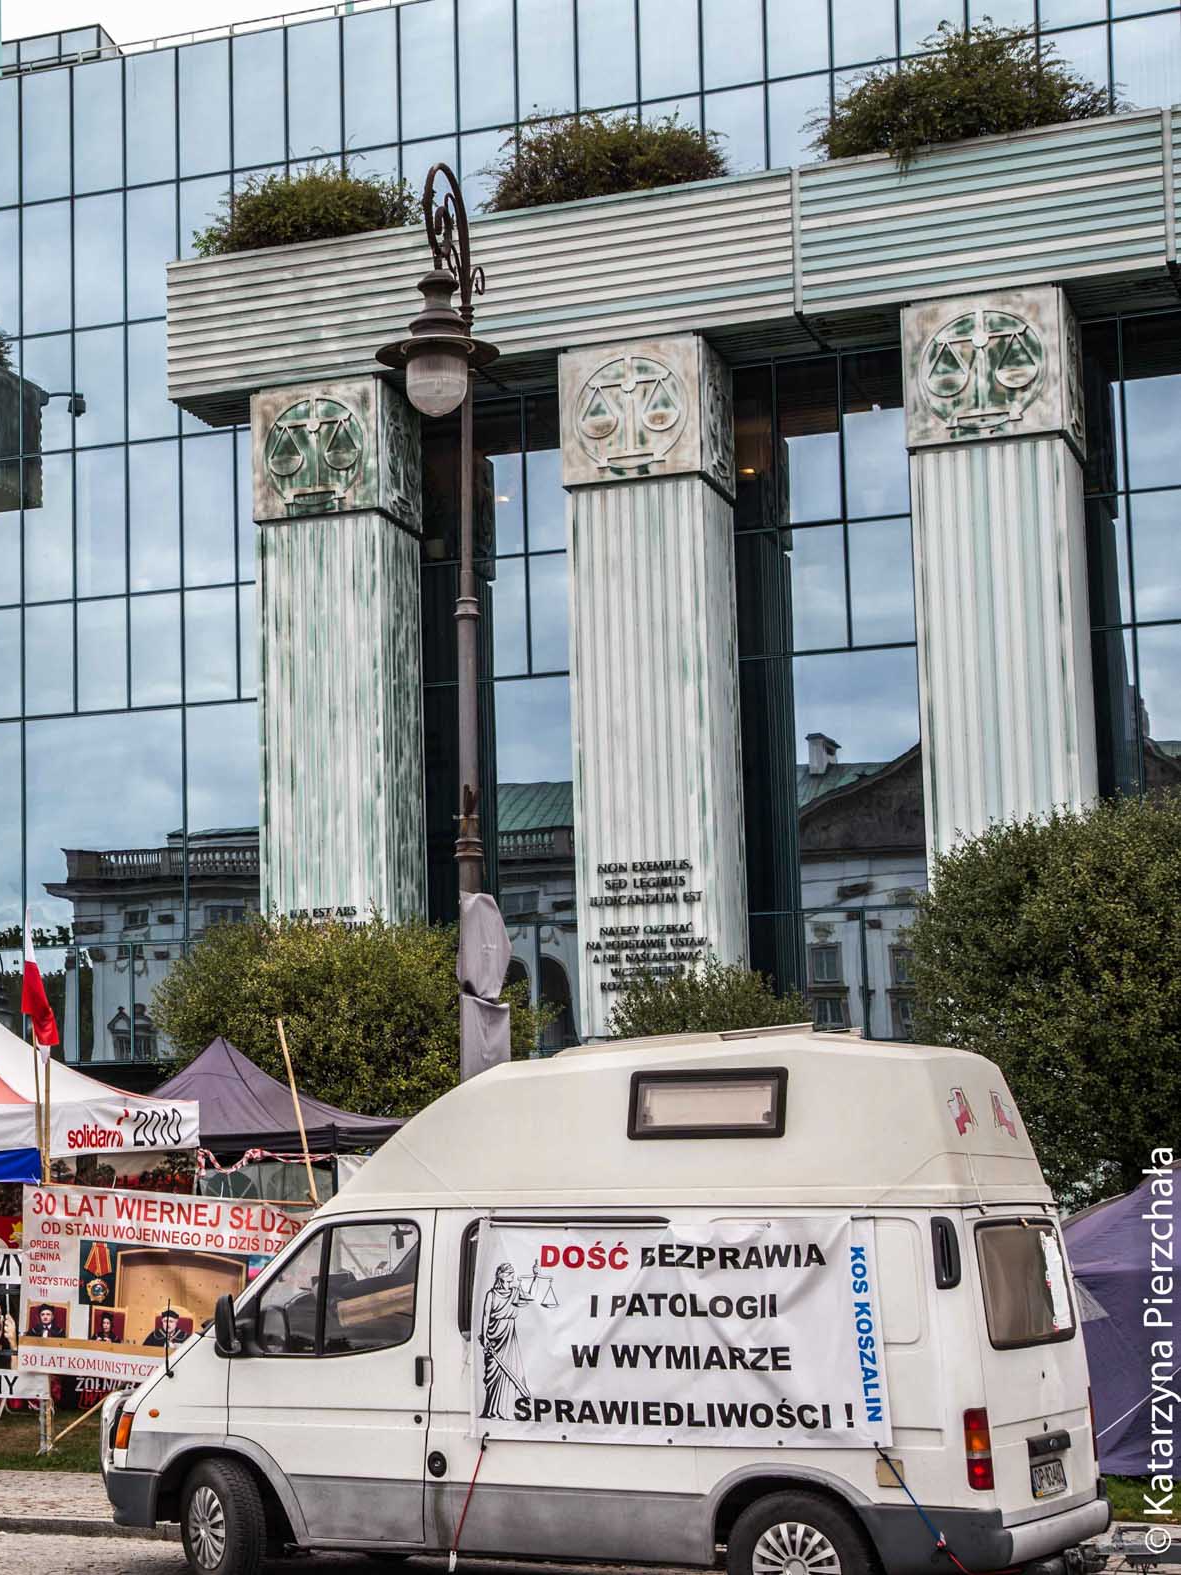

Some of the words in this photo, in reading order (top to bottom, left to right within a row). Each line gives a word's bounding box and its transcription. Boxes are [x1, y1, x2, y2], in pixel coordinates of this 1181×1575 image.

[597, 863, 627, 873] NON
[604, 879, 627, 889] SED
[682, 891, 703, 902] EST
[133, 1107, 182, 1147] 2010
[32, 1192, 56, 1216] 30
[63, 1196, 107, 1219] LAT
[115, 1196, 220, 1227] WIERNEJ
[229, 1206, 307, 1236] SŁUŻB
[30, 1240, 60, 1250] ORDER
[41, 1221, 61, 1235] OD
[65, 1223, 109, 1238] STANU
[112, 1225, 201, 1247] WOJENNEGO
[205, 1234, 223, 1248] PO
[229, 1233, 260, 1251] DZIŚ
[30, 1252, 61, 1261] LENINA
[30, 1264, 46, 1273] DLA
[541, 1241, 629, 1270] DOŚĆ
[641, 1243, 827, 1269] BEZPRAWIA
[850, 1246, 868, 1294] KOS
[590, 1295, 598, 1318] I
[610, 1293, 778, 1319] PATOLOGII
[22, 1354, 37, 1367] 30
[40, 1356, 64, 1369] LAT
[68, 1357, 160, 1377] KOMUNISTYCZ
[571, 1344, 600, 1369] W
[610, 1345, 792, 1371] WYMIARZE
[854, 1302, 883, 1422] KOSZALIN
[515, 1397, 832, 1429] SPRAWIEDLIWOŚCI
